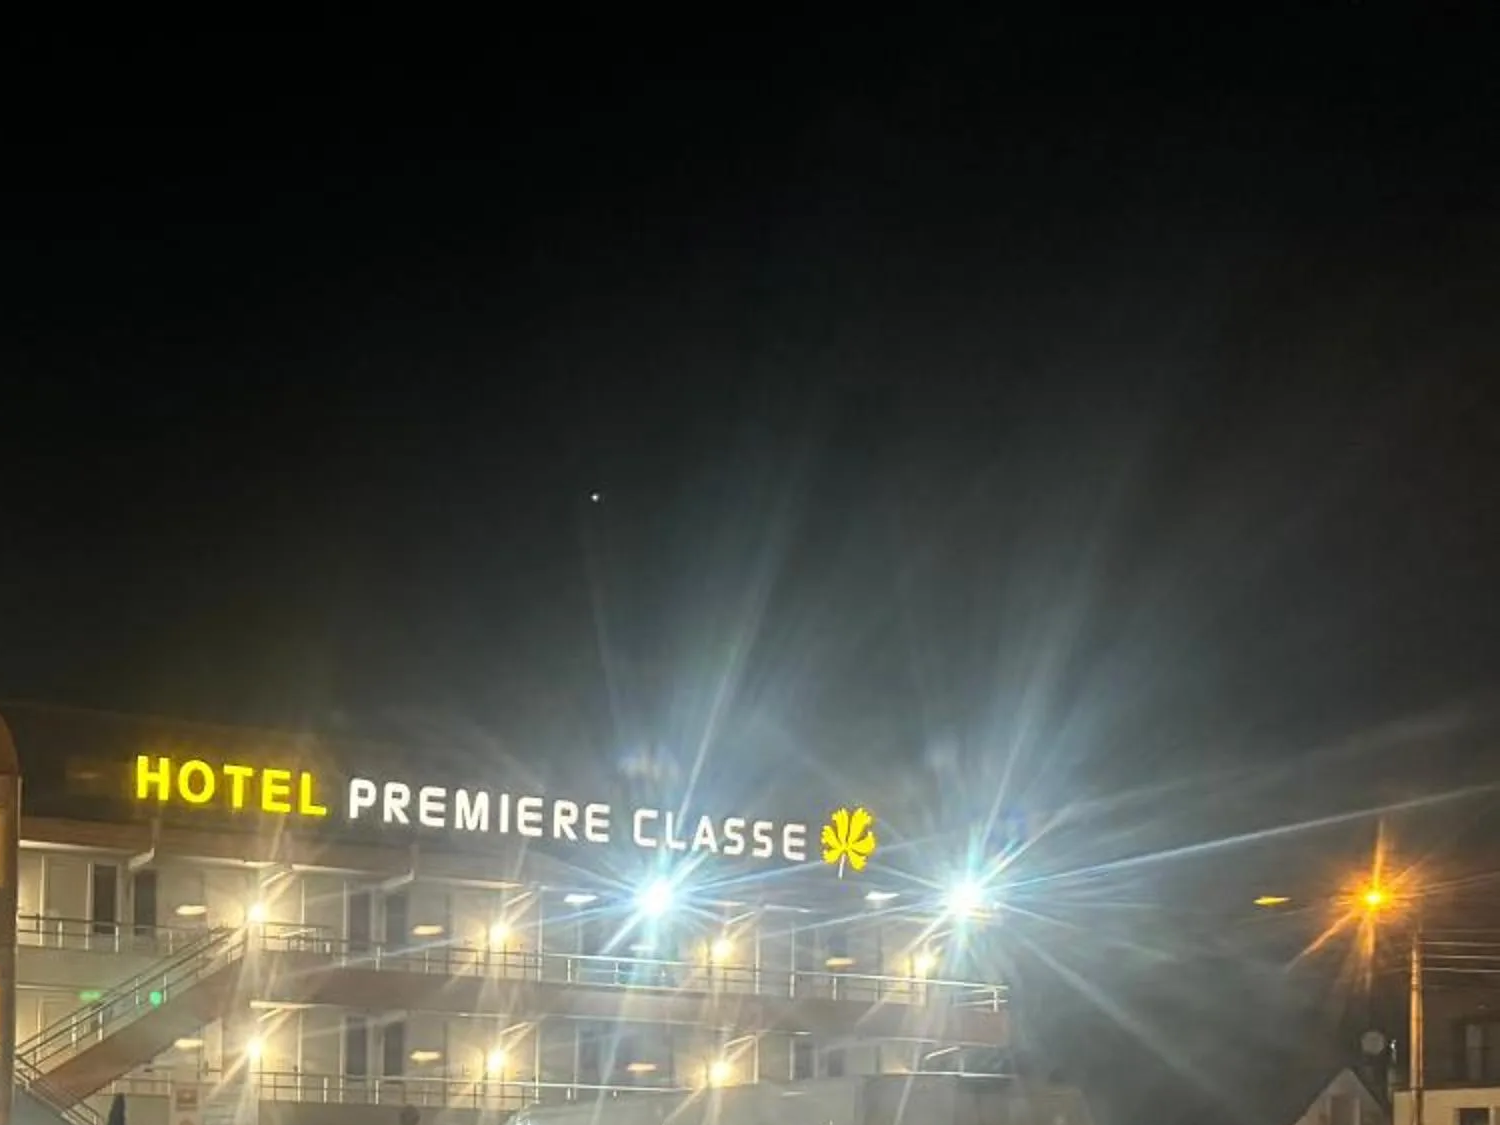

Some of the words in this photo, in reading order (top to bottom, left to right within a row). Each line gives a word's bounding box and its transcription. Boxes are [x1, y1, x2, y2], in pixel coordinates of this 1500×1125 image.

[137, 755, 327, 816] HOTEL
[349, 778, 611, 843] PREMIERE
[632, 808, 807, 861] CLASSE
